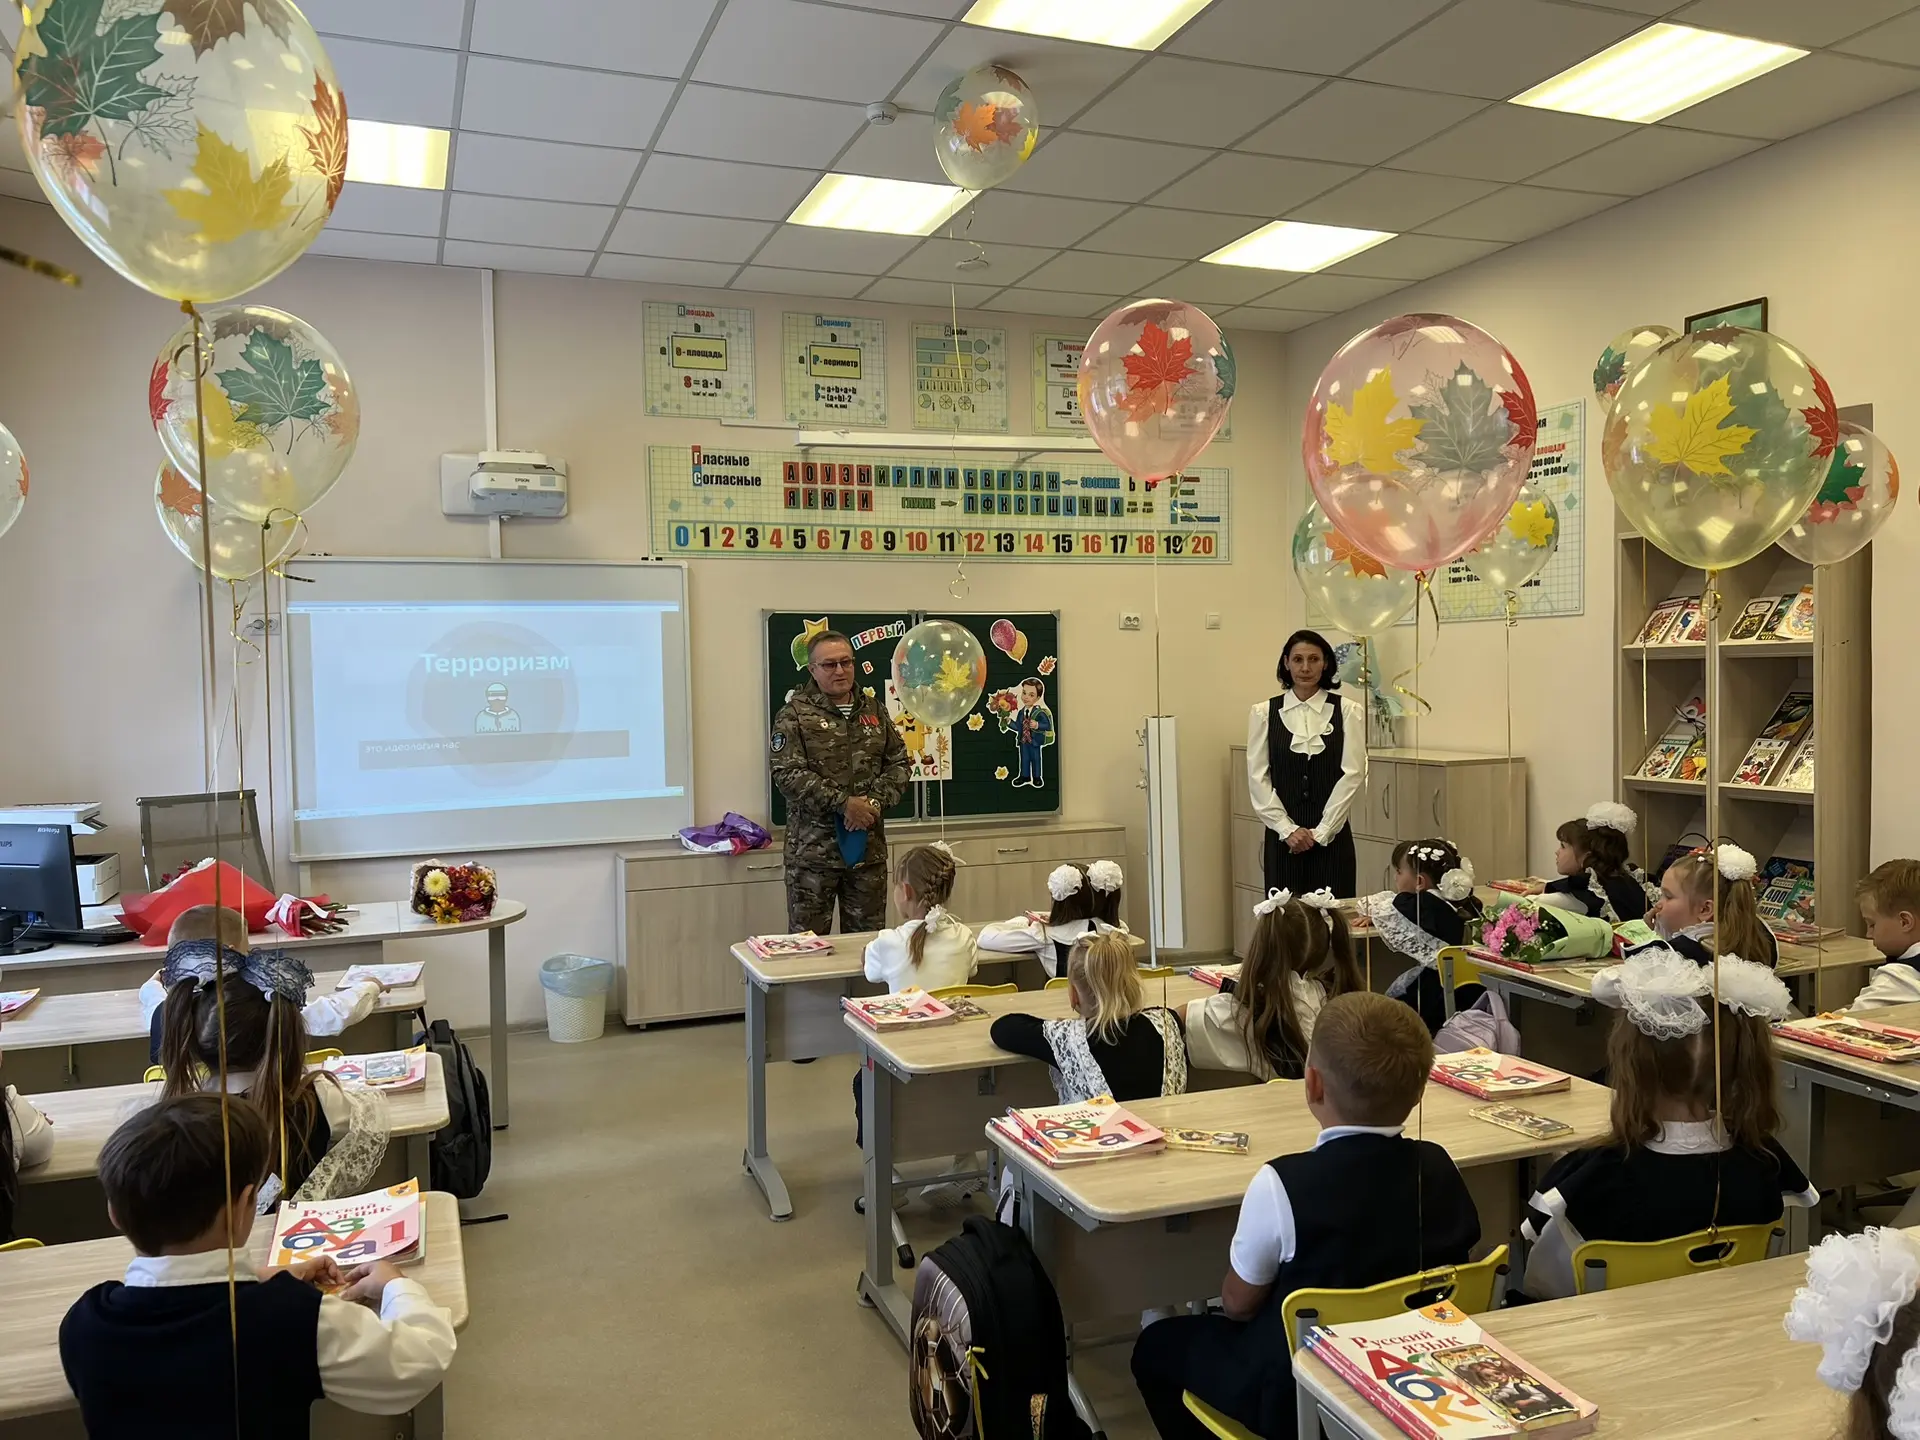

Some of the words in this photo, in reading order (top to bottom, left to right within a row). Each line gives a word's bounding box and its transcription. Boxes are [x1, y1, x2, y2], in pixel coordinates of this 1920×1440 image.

[687, 349, 722, 359] площадь
[824, 358, 858, 368] периметр
[693, 452, 750, 467] Гласные
[693, 472, 762, 487] Согласные
[1081, 477, 1120, 489] ЗВОНКИЕ
[675, 525, 690, 547] 0
[700, 526, 711, 547] 1
[721, 527, 734, 548] 2
[746, 527, 759, 548] 3
[769, 528, 783, 548] 4
[793, 528, 806, 550] 5
[817, 528, 830, 550] 6
[840, 530, 851, 550] 7
[860, 530, 873, 550] 8
[883, 530, 896, 551] 9
[905, 531, 928, 551] 10
[937, 532, 955, 552] 11
[964, 532, 985, 552] 12
[994, 532, 1015, 553] 13
[1024, 533, 1044, 553] 14
[1052, 534, 1073, 553] 15
[1082, 534, 1102, 554] 16
[1110, 534, 1128, 554] 17
[1135, 535, 1155, 554] 18
[1164, 535, 1184, 554] 19
[1192, 536, 1213, 554] 20
[851, 621, 905, 649] ПЕРВЫЙ
[419, 653, 570, 678] Терроризм
[913, 765, 938, 777] АСС
[1765, 889, 1788, 904] 400
[1349, 1329, 1435, 1349] Русский
